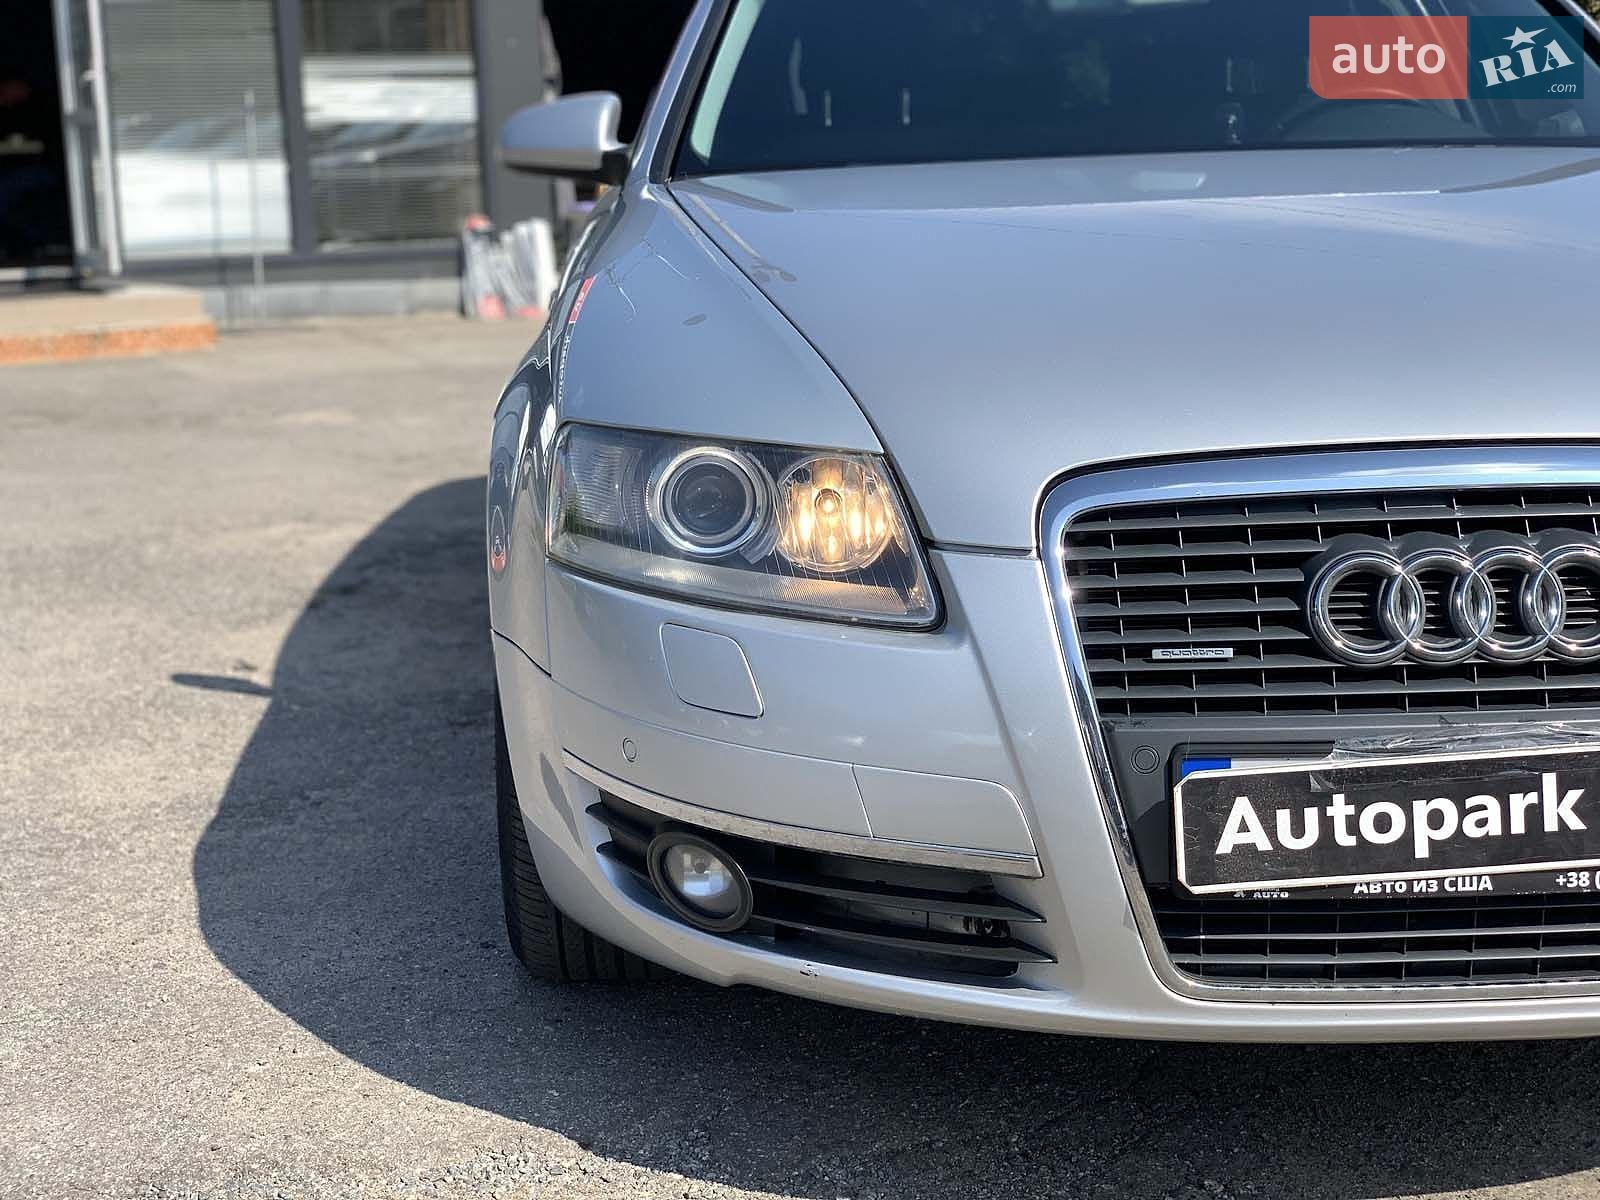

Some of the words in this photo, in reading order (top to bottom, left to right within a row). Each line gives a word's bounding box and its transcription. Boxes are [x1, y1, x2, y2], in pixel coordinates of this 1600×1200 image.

[1160, 648, 1225, 658] quattro
[1215, 772, 1587, 859] Autopark
[1444, 875, 1494, 892] США
